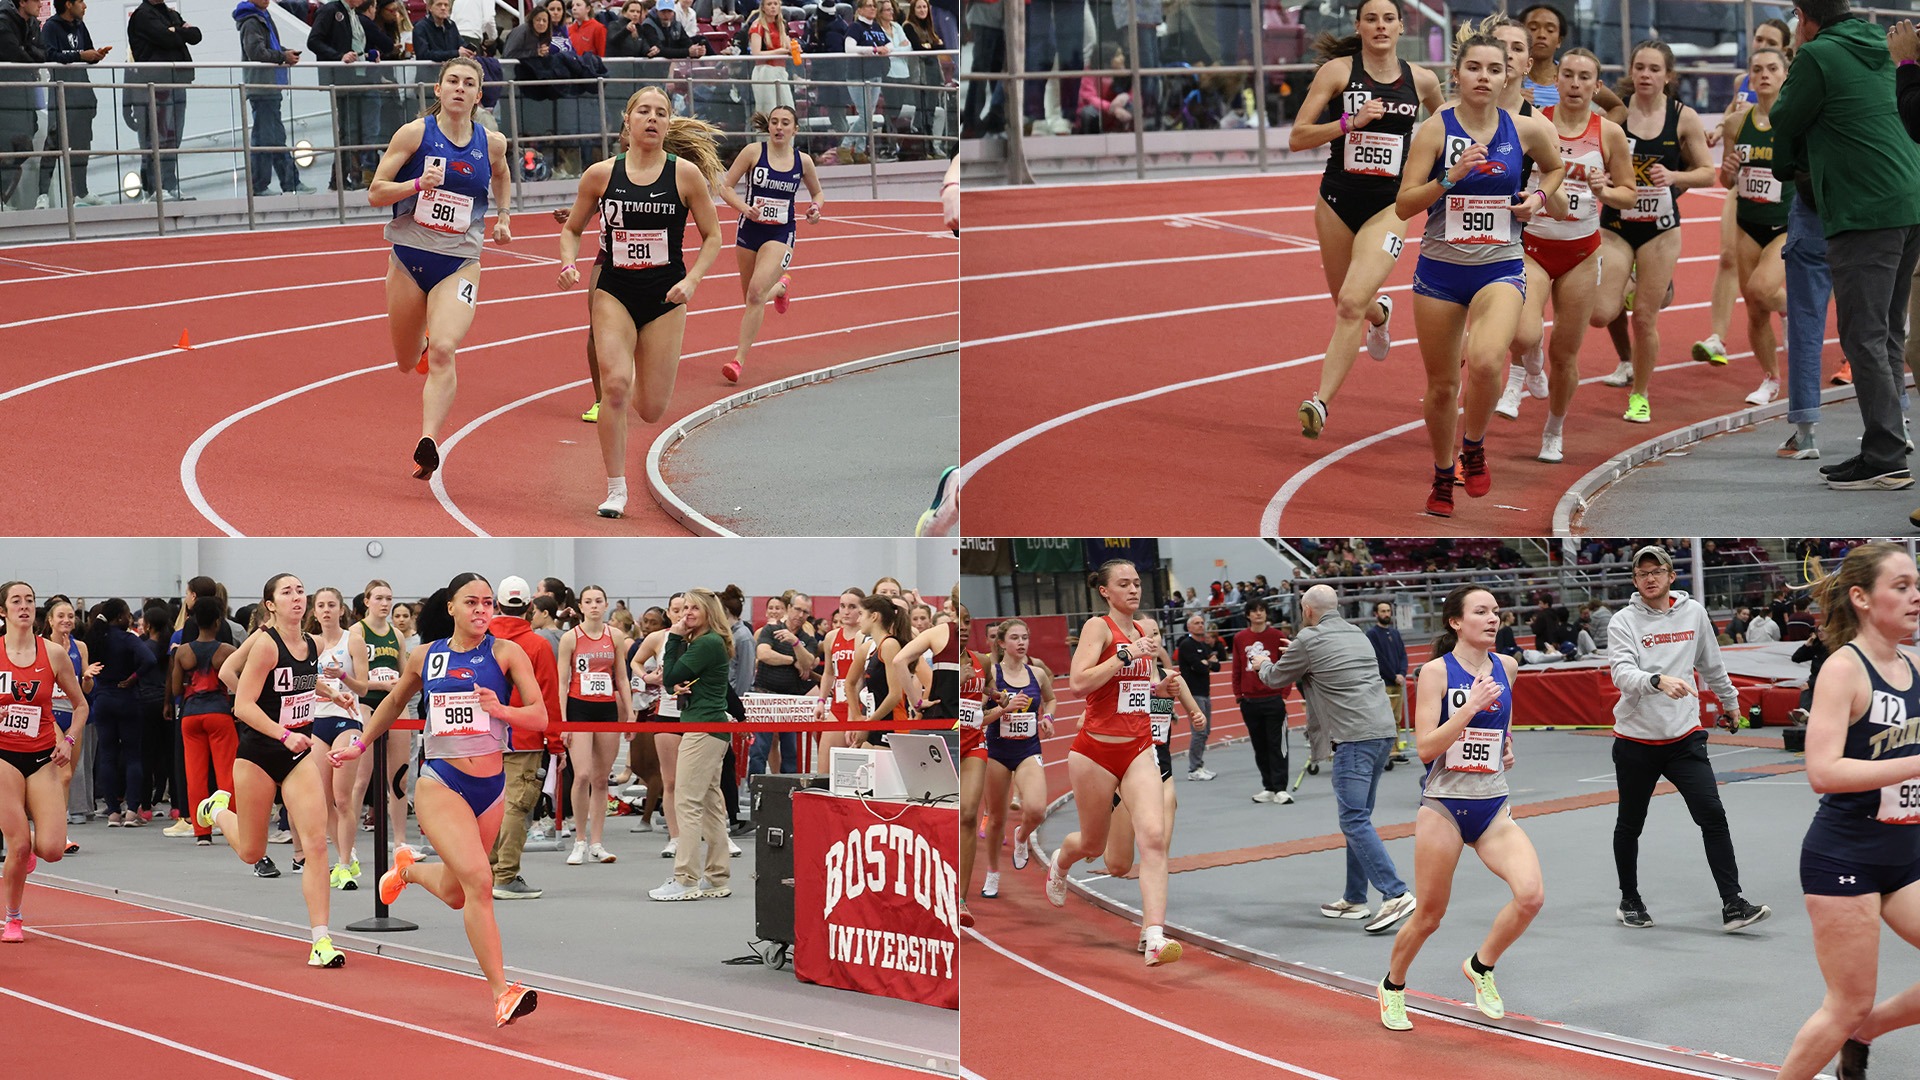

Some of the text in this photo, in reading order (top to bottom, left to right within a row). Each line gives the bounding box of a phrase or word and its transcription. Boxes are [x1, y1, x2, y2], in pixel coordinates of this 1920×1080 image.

[1348, 92, 1367, 114] 13
[1354, 146, 1392, 165] 2659
[756, 168, 765, 184] 9
[763, 178, 798, 193] TONEHILL
[1746, 179, 1771, 194] 1097
[432, 203, 455, 223] 981
[624, 201, 675, 215] TMOUTH
[763, 206, 778, 218] 881
[1463, 212, 1494, 231] 990
[627, 243, 651, 259] 281
[1390, 236, 1403, 259] 13
[782, 253, 791, 268] 9
[461, 283, 473, 304] 4
[960, 538, 996, 551] EHIGH
[432, 654, 444, 677] 9
[578, 658, 587, 672] 8
[278, 668, 290, 690] 4
[590, 681, 605, 691] 789
[1129, 693, 1146, 707] 262
[292, 703, 310, 720] 1118
[445, 707, 474, 724] 989
[960, 709, 974, 722] 261
[1881, 695, 1901, 726] 12
[4, 714, 29, 730] 1139
[1009, 721, 1029, 733] 1163
[1463, 743, 1490, 761] 995
[824, 824, 959, 939] BOSTON
[828, 923, 955, 980] UNIVERSITY
